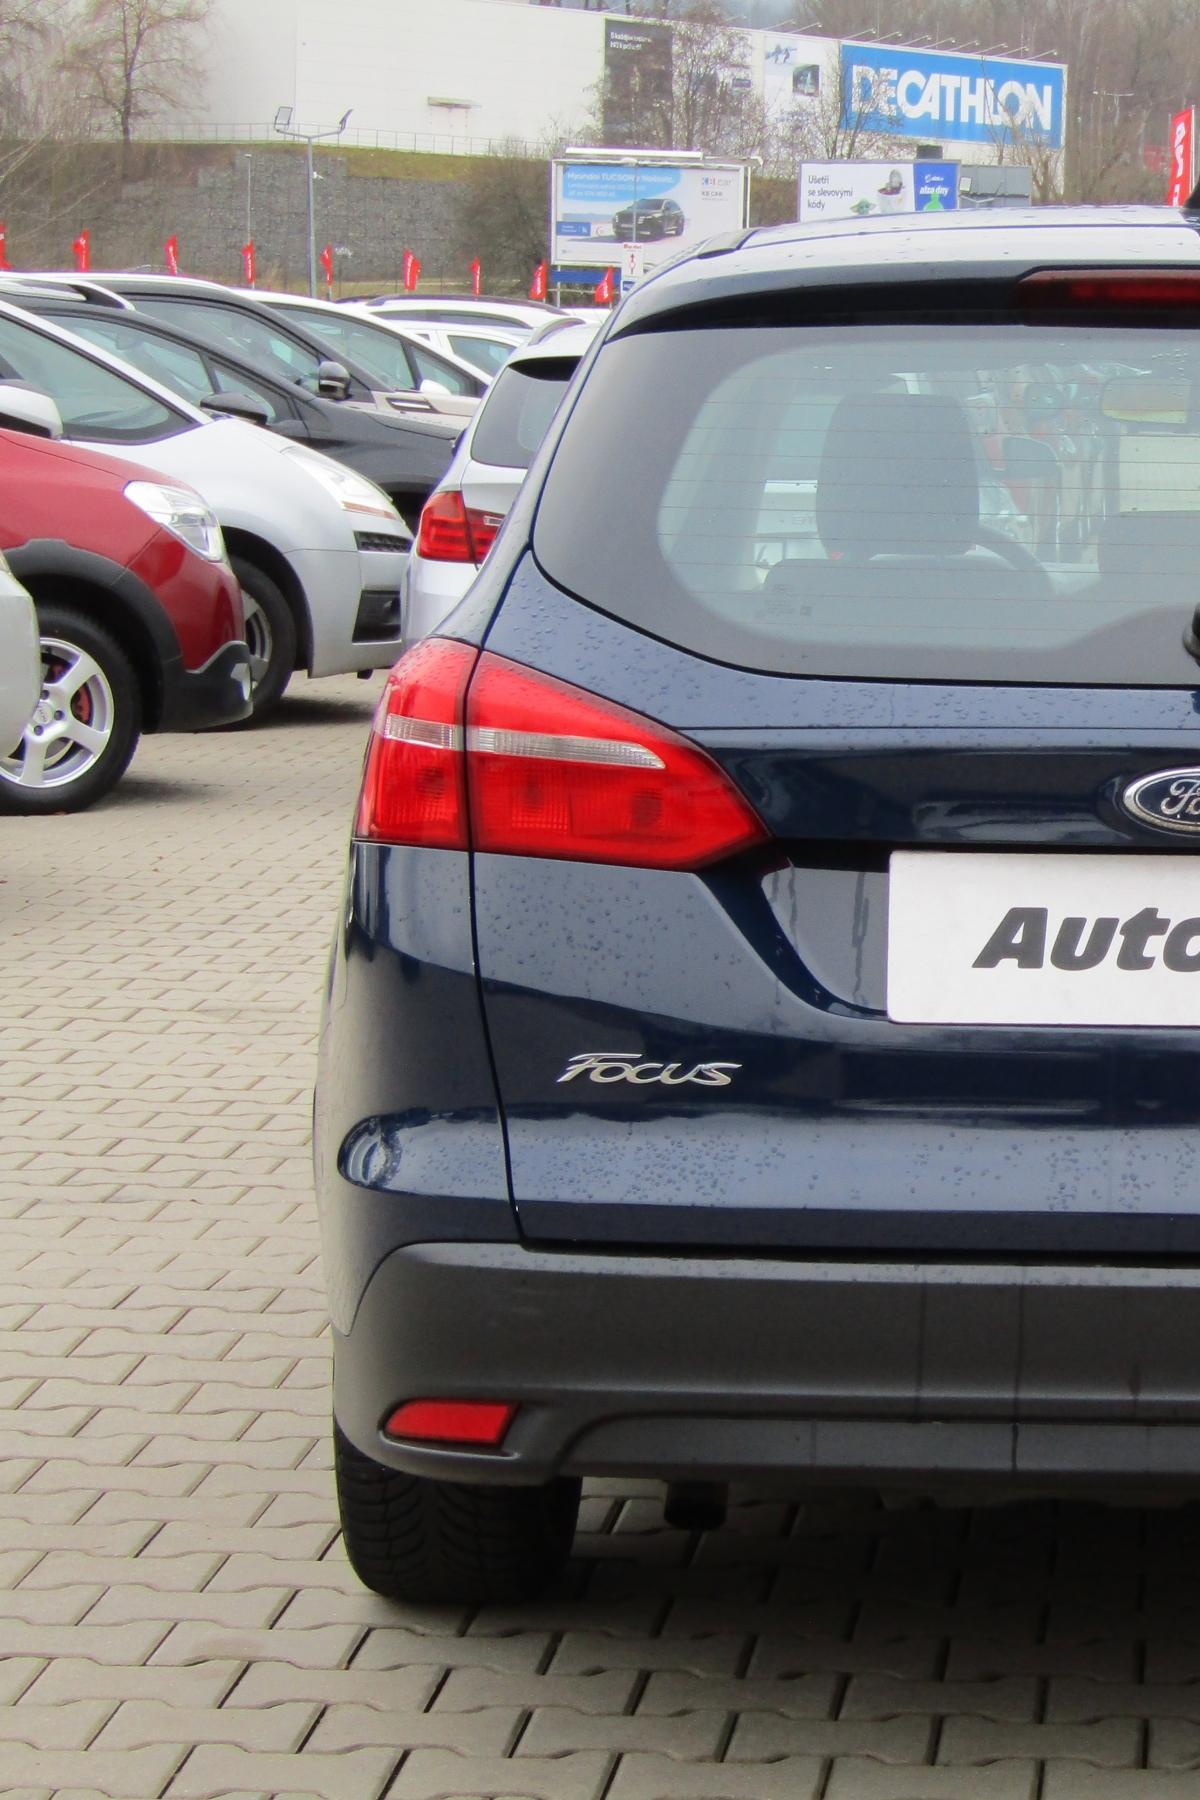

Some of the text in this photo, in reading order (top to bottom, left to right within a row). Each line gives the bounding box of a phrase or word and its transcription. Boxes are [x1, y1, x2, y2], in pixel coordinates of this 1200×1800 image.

[851, 65, 1053, 131] DECATHLON
[808, 174, 830, 184] Ušetři
[817, 188, 853, 199] slevovými
[556, 1052, 743, 1086] Focus
